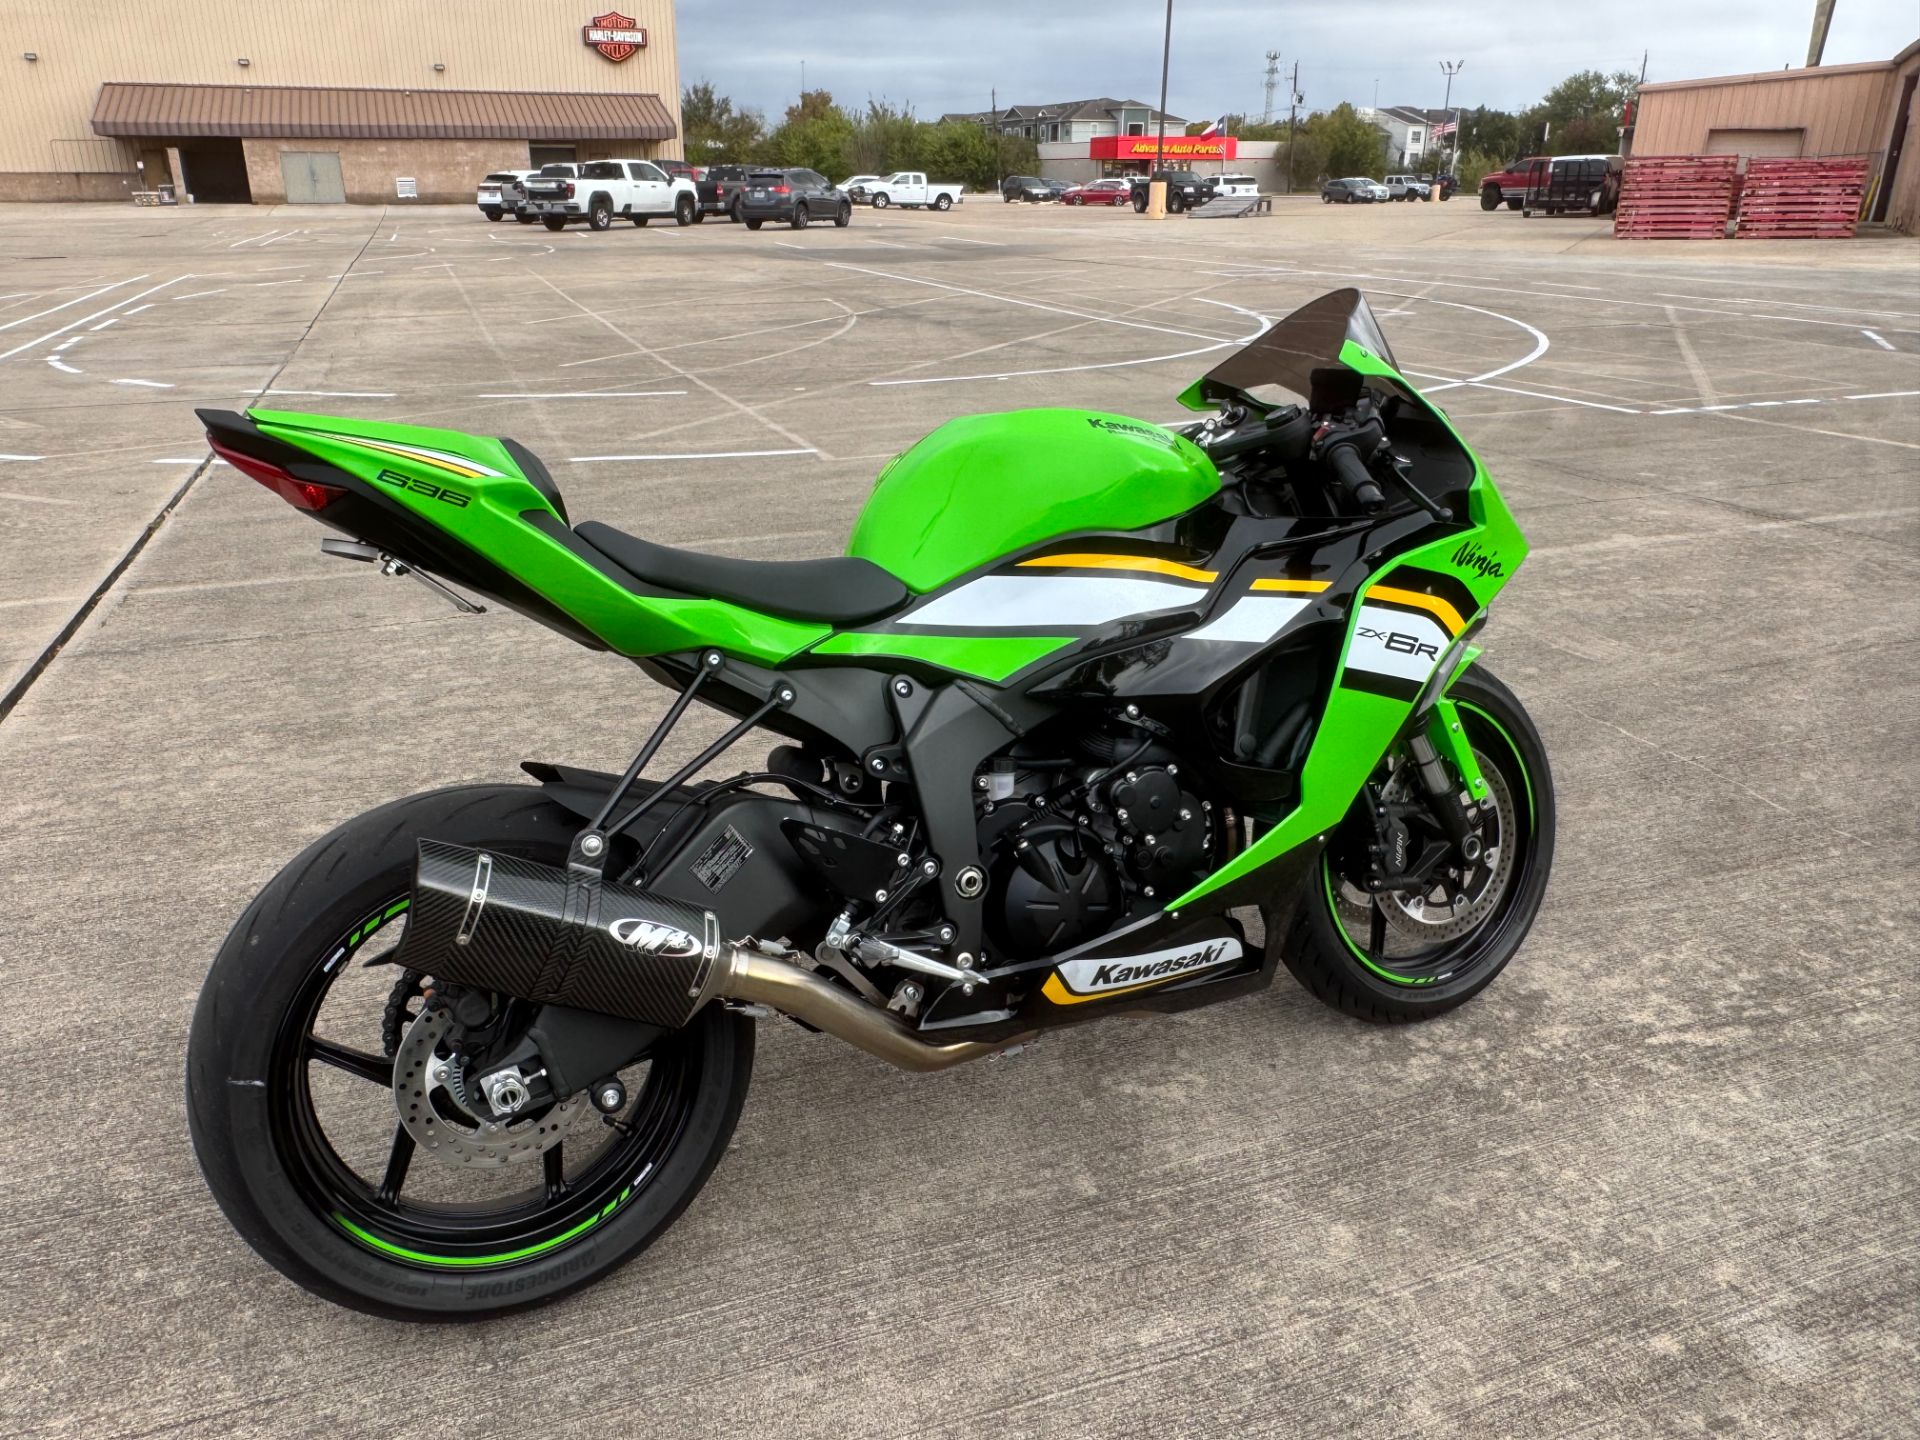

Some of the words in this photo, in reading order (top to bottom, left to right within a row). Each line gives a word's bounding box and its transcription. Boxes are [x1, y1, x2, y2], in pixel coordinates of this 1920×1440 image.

[1131, 144, 1169, 153] Advane
[1169, 144, 1191, 154] Auto
[1192, 144, 1217, 154] Parts
[376, 468, 472, 508] 636
[1450, 541, 1505, 580] Ninja
[1355, 626, 1439, 662] ZX-6R
[1089, 941, 1229, 987] Kawasaki
